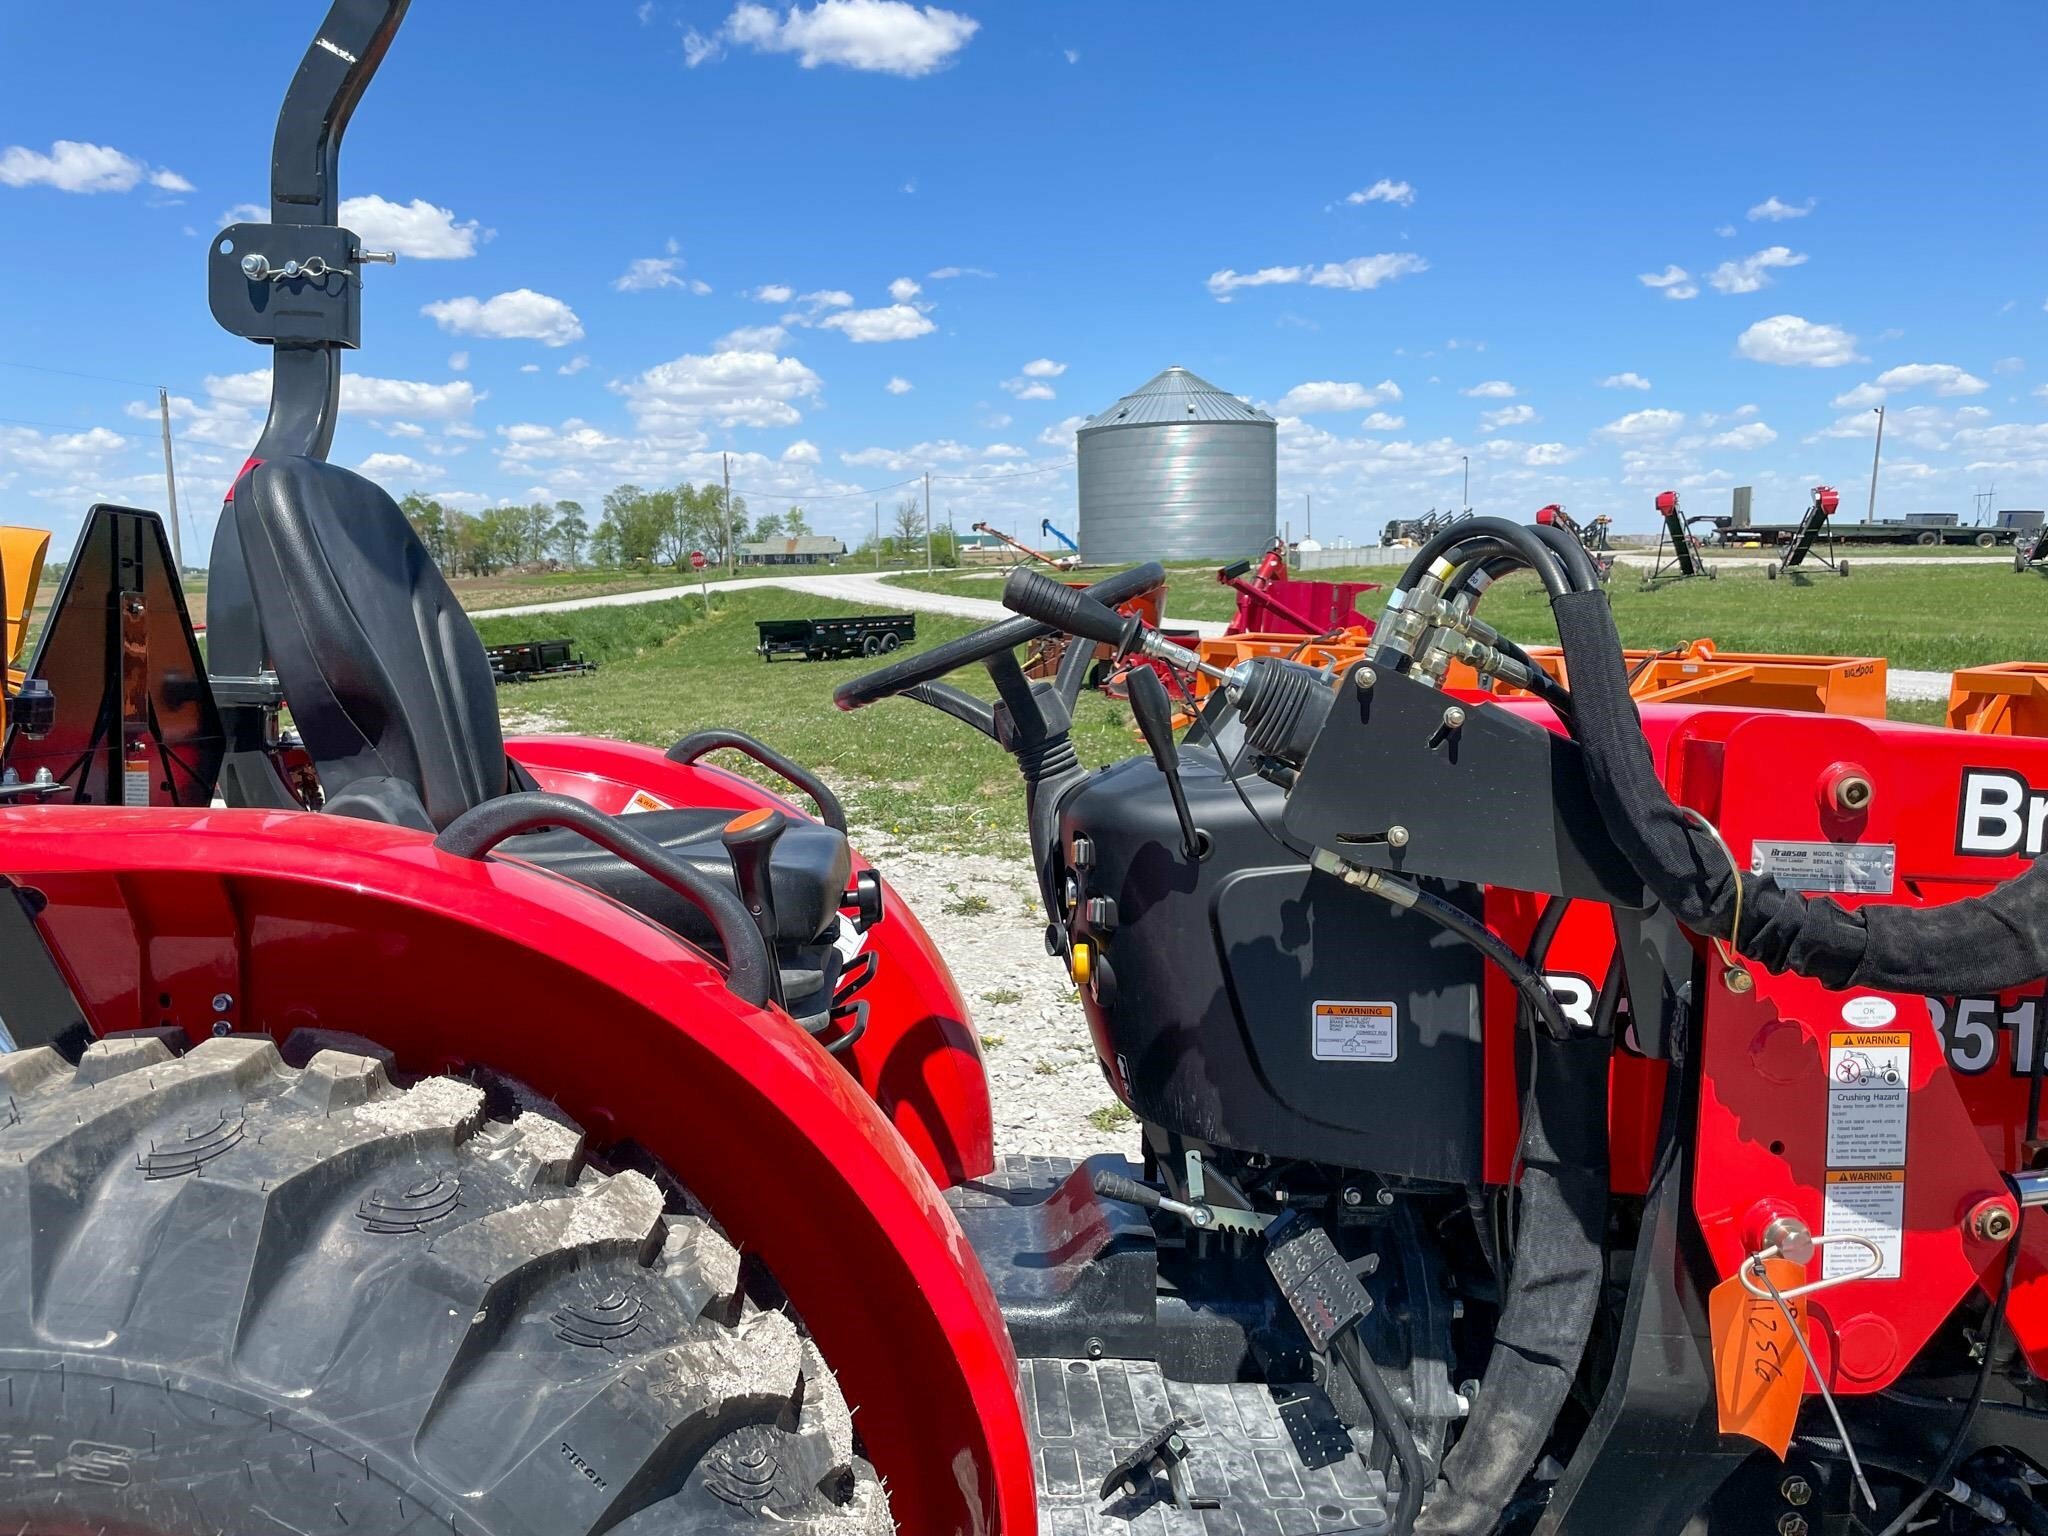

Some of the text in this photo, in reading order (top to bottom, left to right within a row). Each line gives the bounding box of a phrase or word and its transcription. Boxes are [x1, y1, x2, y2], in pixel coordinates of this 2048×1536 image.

[1771, 848, 1807, 857] Branson
[1340, 1007, 1382, 1015] WARNING
[1857, 1036, 1900, 1044] WARNING
[1838, 1092, 1900, 1102] Crushing Hazard
[1850, 1172, 1893, 1181] WARNING
